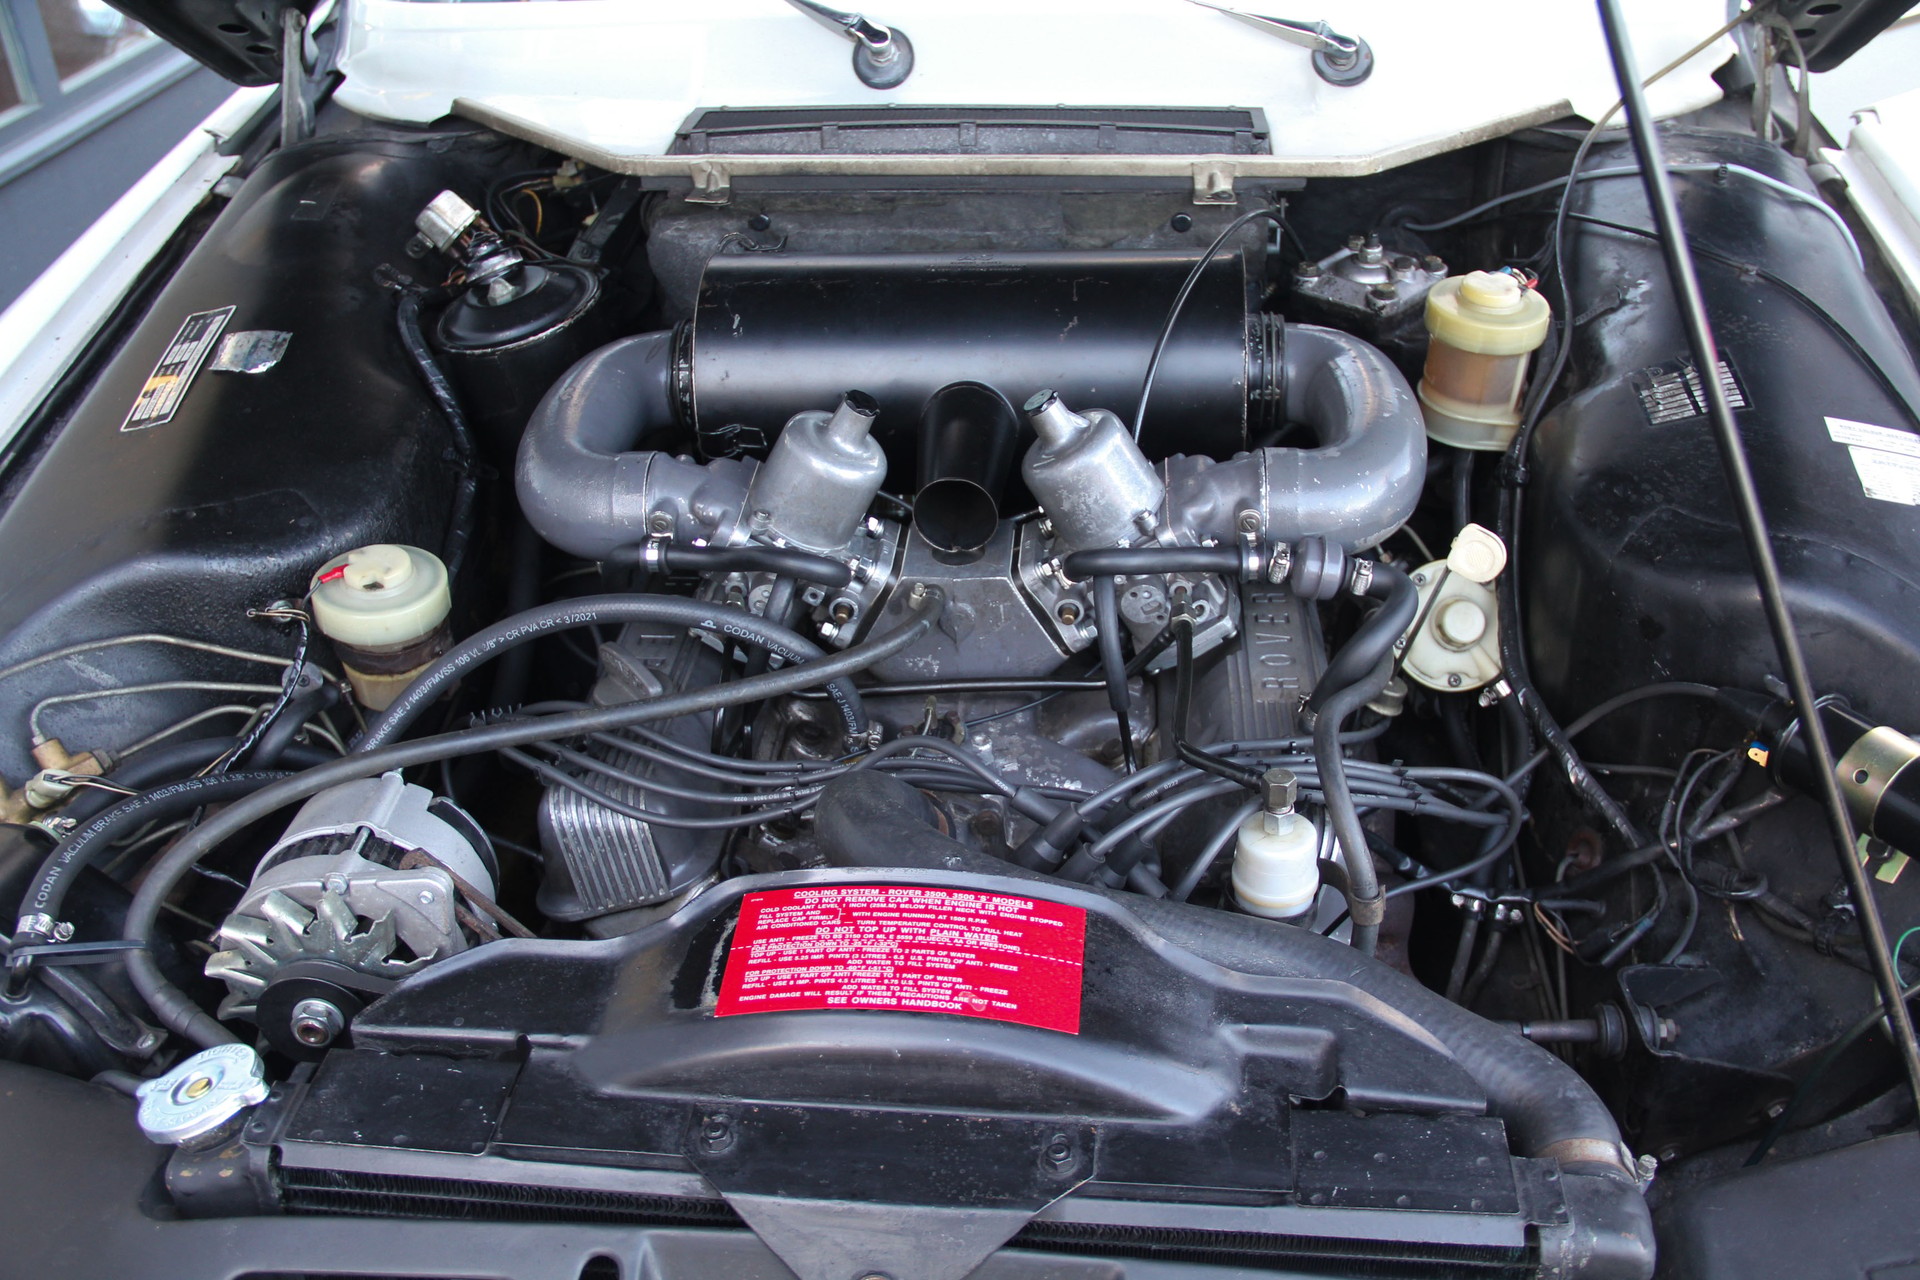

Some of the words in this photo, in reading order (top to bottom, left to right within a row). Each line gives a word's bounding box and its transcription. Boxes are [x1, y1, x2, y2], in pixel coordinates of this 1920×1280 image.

[724, 625, 764, 644] CODAN
[766, 640, 804, 665] VACUUM
[1251, 593, 1298, 688] ROVER
[365, 723, 391, 751] BRAKE
[388, 707, 406, 725] SAE
[405, 702, 410, 710] J
[409, 664, 456, 704] 1403/FMVSS
[455, 654, 470, 668] 106
[469, 648, 482, 658] VL
[506, 628, 520, 640] CR
[520, 623, 539, 635] PVA
[540, 618, 554, 630] CR
[826, 683, 842, 698] SAE
[34, 866, 62, 908] CODAN
[58, 829, 97, 864] VACUUM
[92, 810, 122, 832] BRAKE
[150, 780, 202, 801] 1403/FMVSS
[202, 777, 217, 786] 106
[794, 890, 836, 898] COOLING
[838, 889, 880, 897] SYSTEM
[888, 889, 922, 897] ROVER
[952, 892, 975, 902] 3500
[992, 896, 1033, 909] MODELS
[805, 897, 819, 905] DO
[822, 896, 842, 904] NOT
[845, 896, 885, 904] REMOVE
[889, 896, 909, 904] CAP
[912, 897, 941, 905] WHEN
[944, 898, 982, 909] ENGINE
[998, 904, 1019, 914] HOT
[879, 920, 930, 928] TEMPERATURE
[1000, 912, 1026, 920] ENGINE
[916, 935, 950, 943] (BLUECOL
[980, 940, 1020, 951] PRESTONE)
[930, 928, 960, 938] PLAIN
[964, 931, 998, 942] WATER
[896, 991, 950, 1000] PRECAUTIONS
[992, 1000, 1017, 1009] TAKEN
[902, 998, 962, 1009] HANDBOOK
